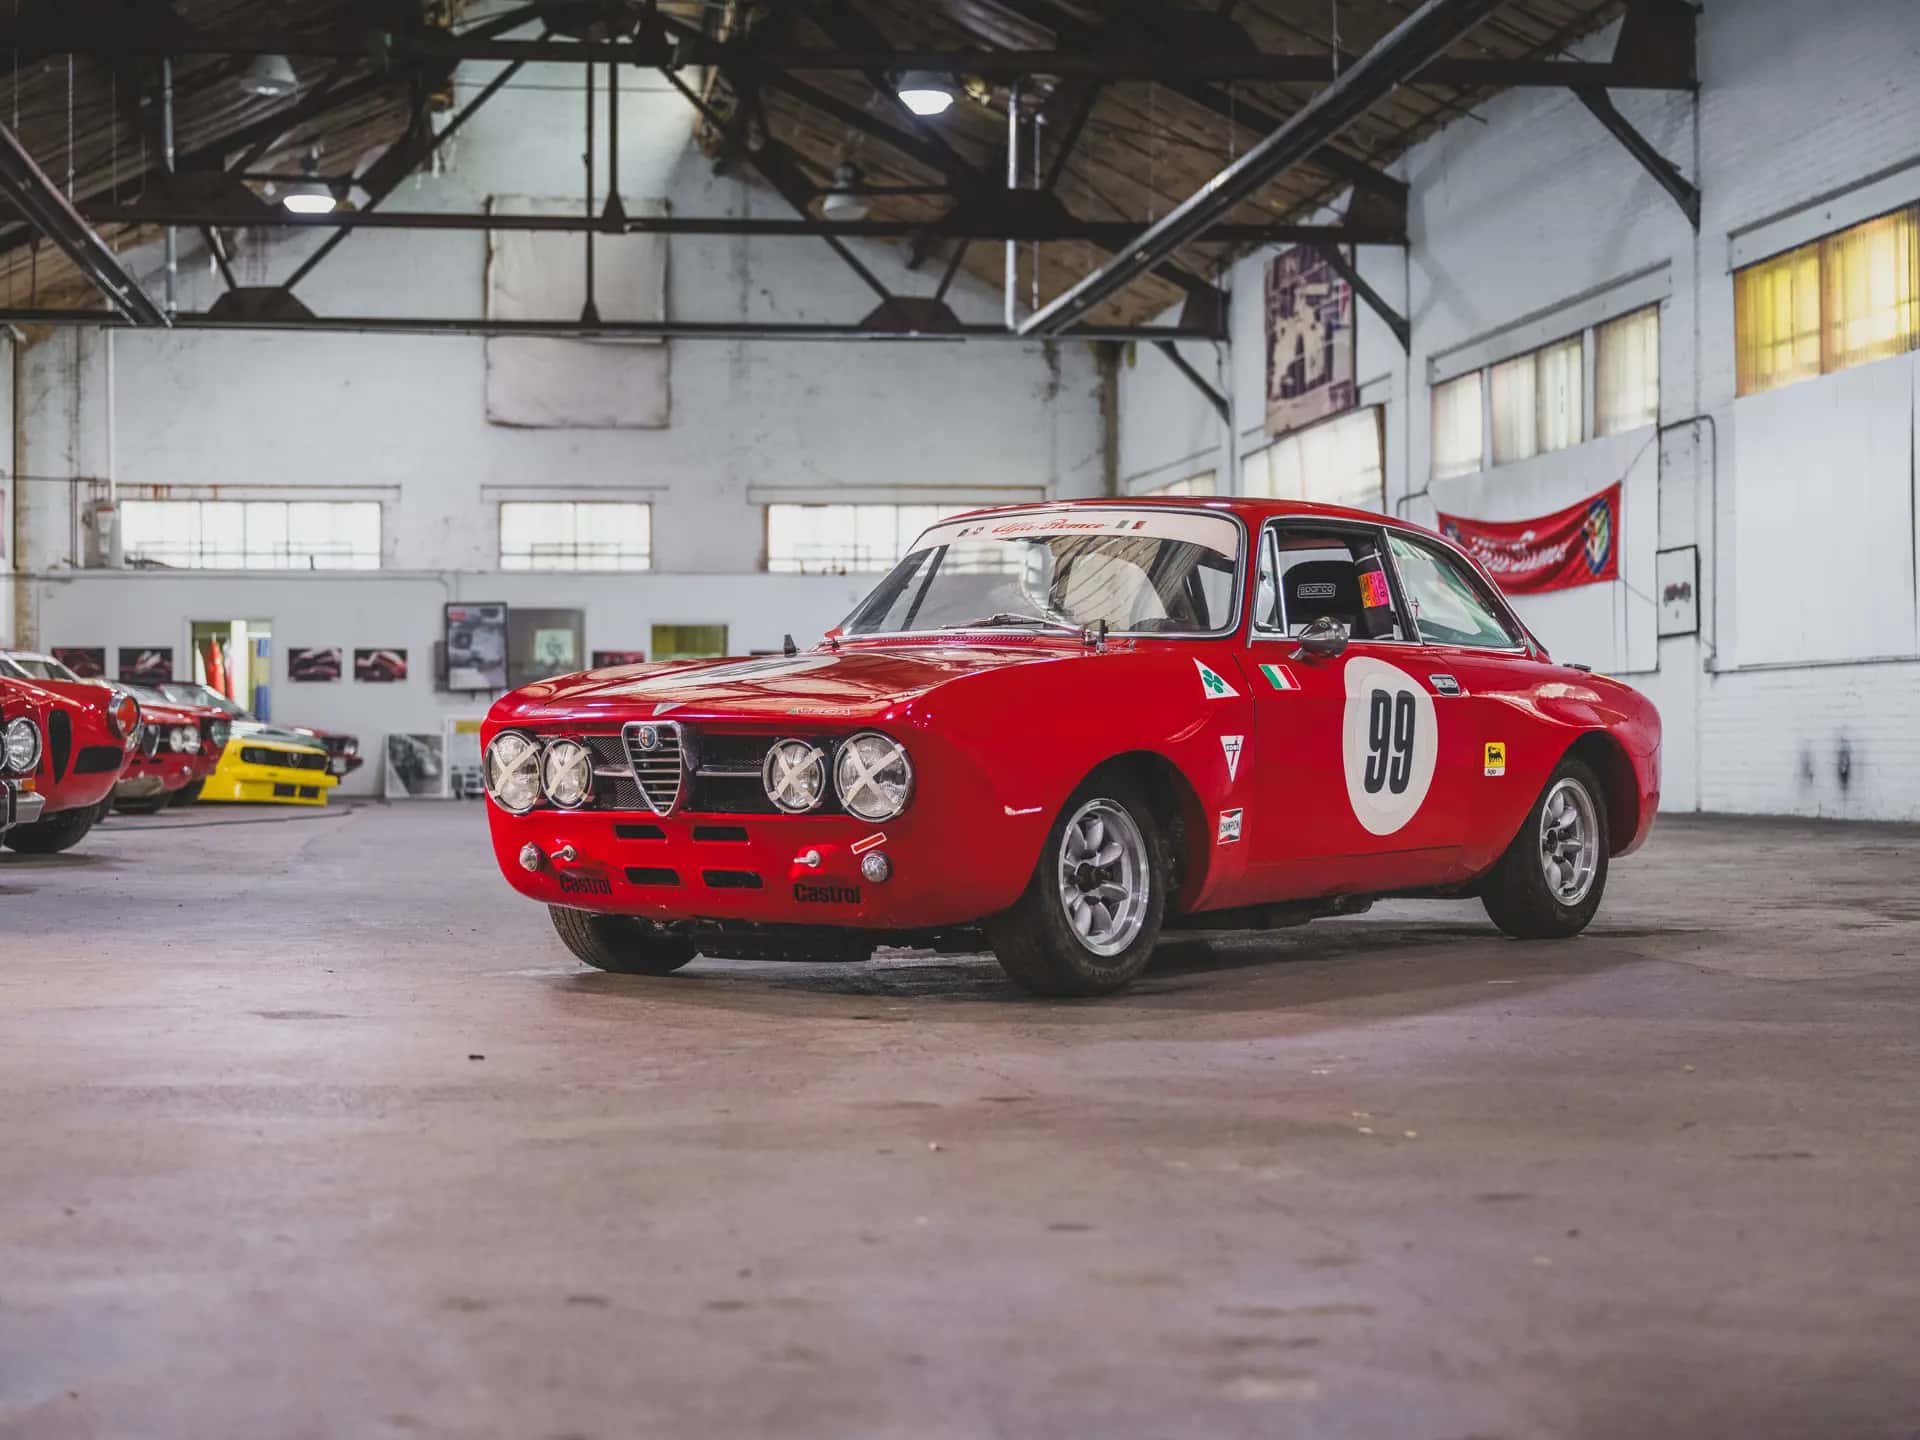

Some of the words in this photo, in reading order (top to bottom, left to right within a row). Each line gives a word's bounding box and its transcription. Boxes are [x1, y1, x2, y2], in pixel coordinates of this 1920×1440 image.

[991, 522, 1032, 534] Alfa
[1040, 518, 1105, 530] Romeo
[1364, 688, 1416, 794] 99
[560, 874, 613, 896] Castrol
[794, 882, 861, 904] Castrol
